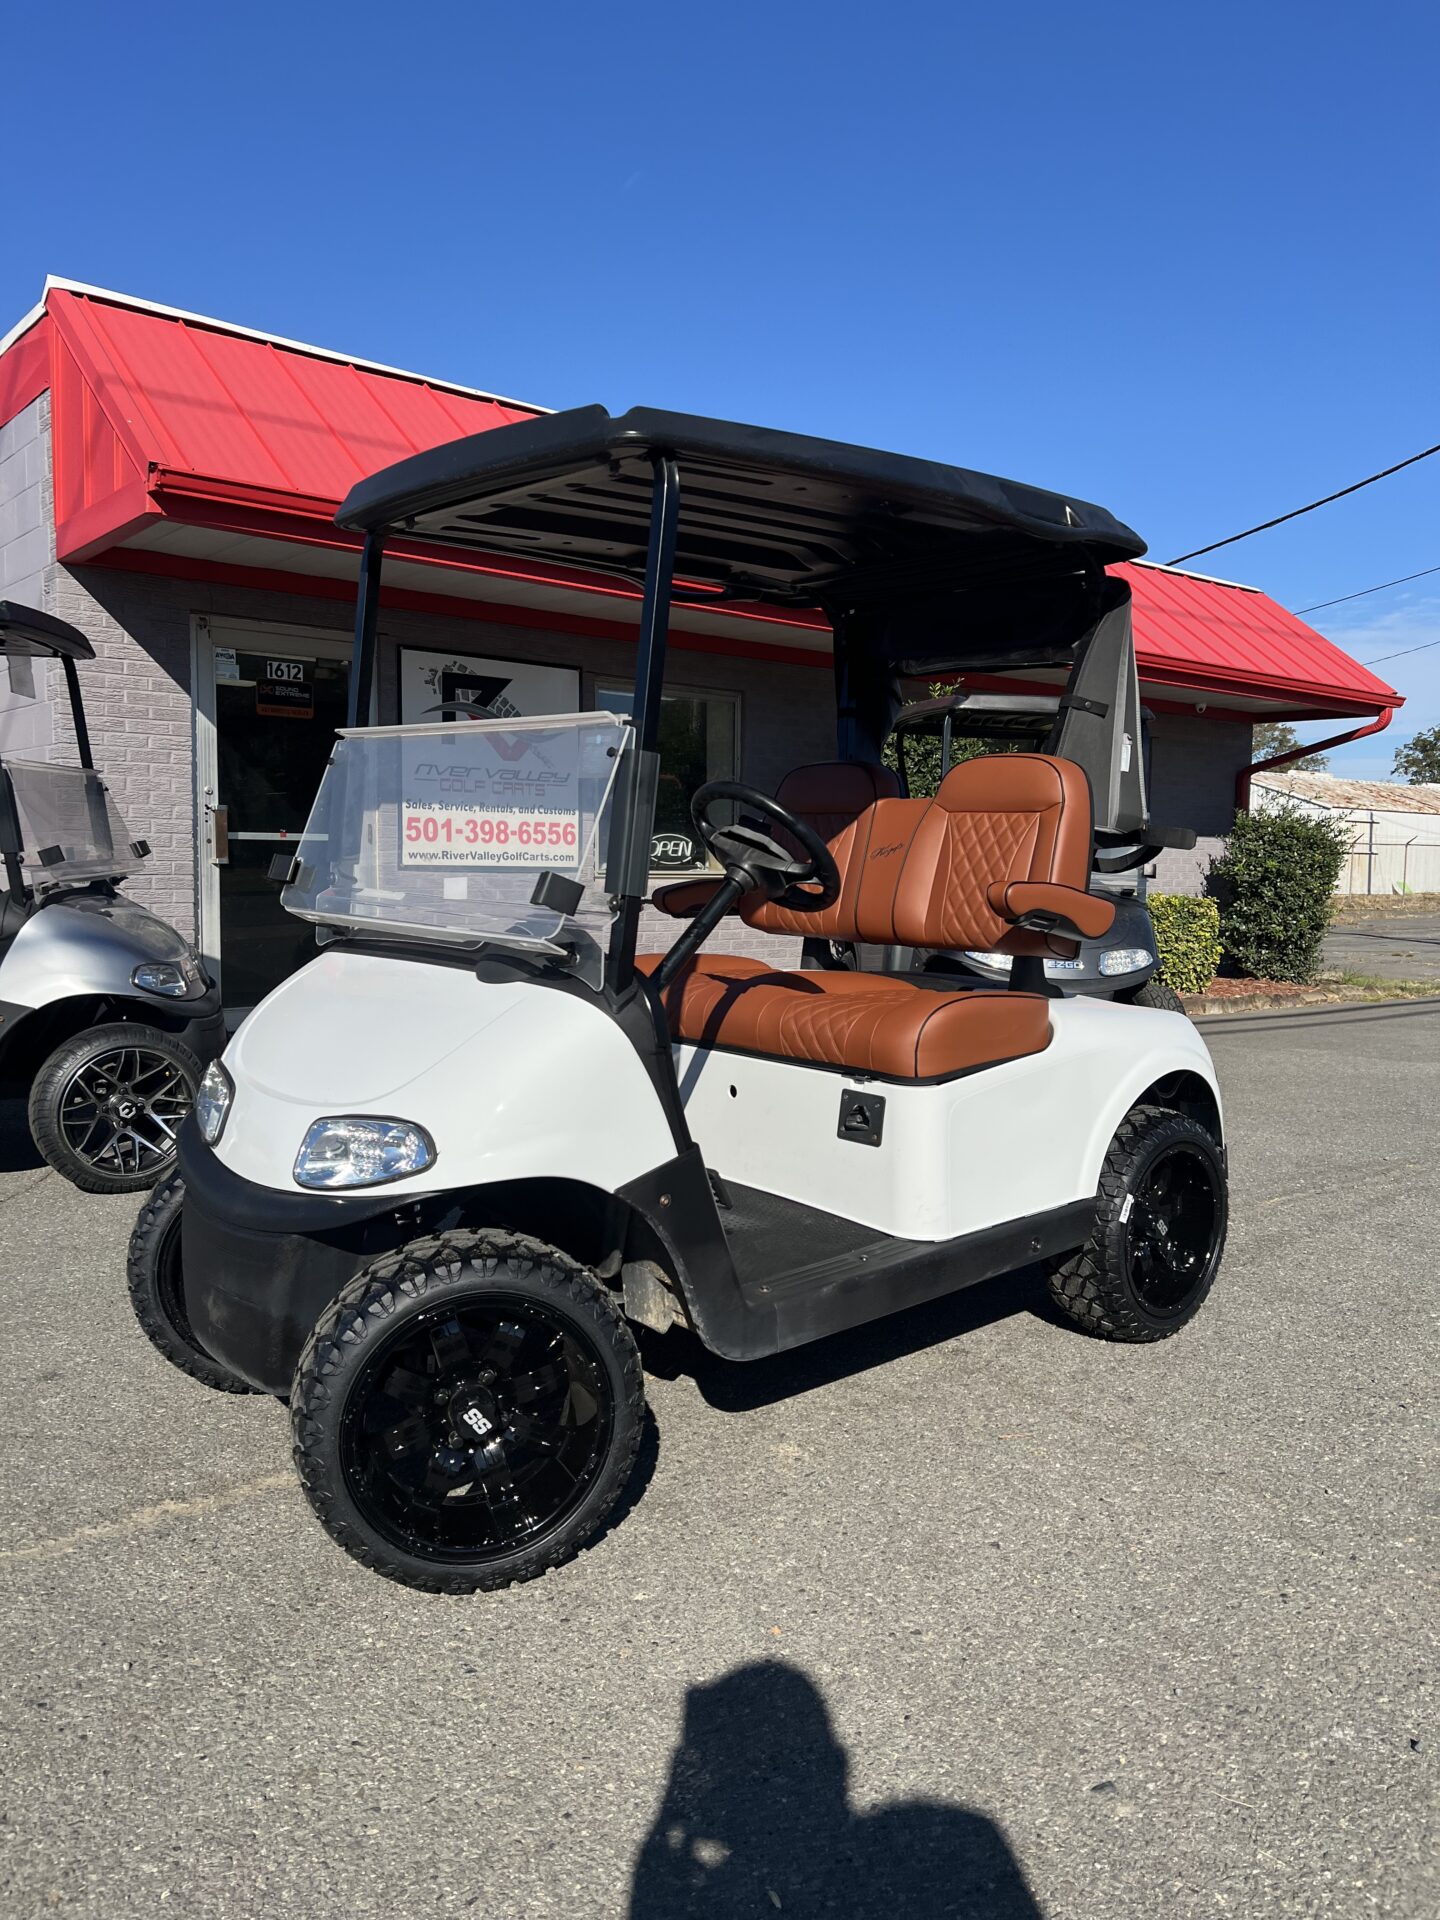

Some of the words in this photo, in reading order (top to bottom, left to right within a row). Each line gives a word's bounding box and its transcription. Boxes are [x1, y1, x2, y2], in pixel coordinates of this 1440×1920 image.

[268, 662, 302, 680] 1612
[275, 685, 299, 693] SOUND
[275, 691, 310, 699] EXTREME
[440, 778, 486, 793] GOLF
[492, 780, 545, 797] CARTS
[405, 798, 435, 812] Sales,
[438, 800, 476, 813] Service,
[478, 802, 515, 815] Rentals,
[518, 803, 534, 814] and
[537, 805, 576, 816] Customs
[405, 816, 577, 846] 501-398-6556
[408, 850, 575, 863] www.RiverValleyGolfCarts.com
[650, 840, 692, 856] OPEN
[462, 1408, 493, 1434] SS
